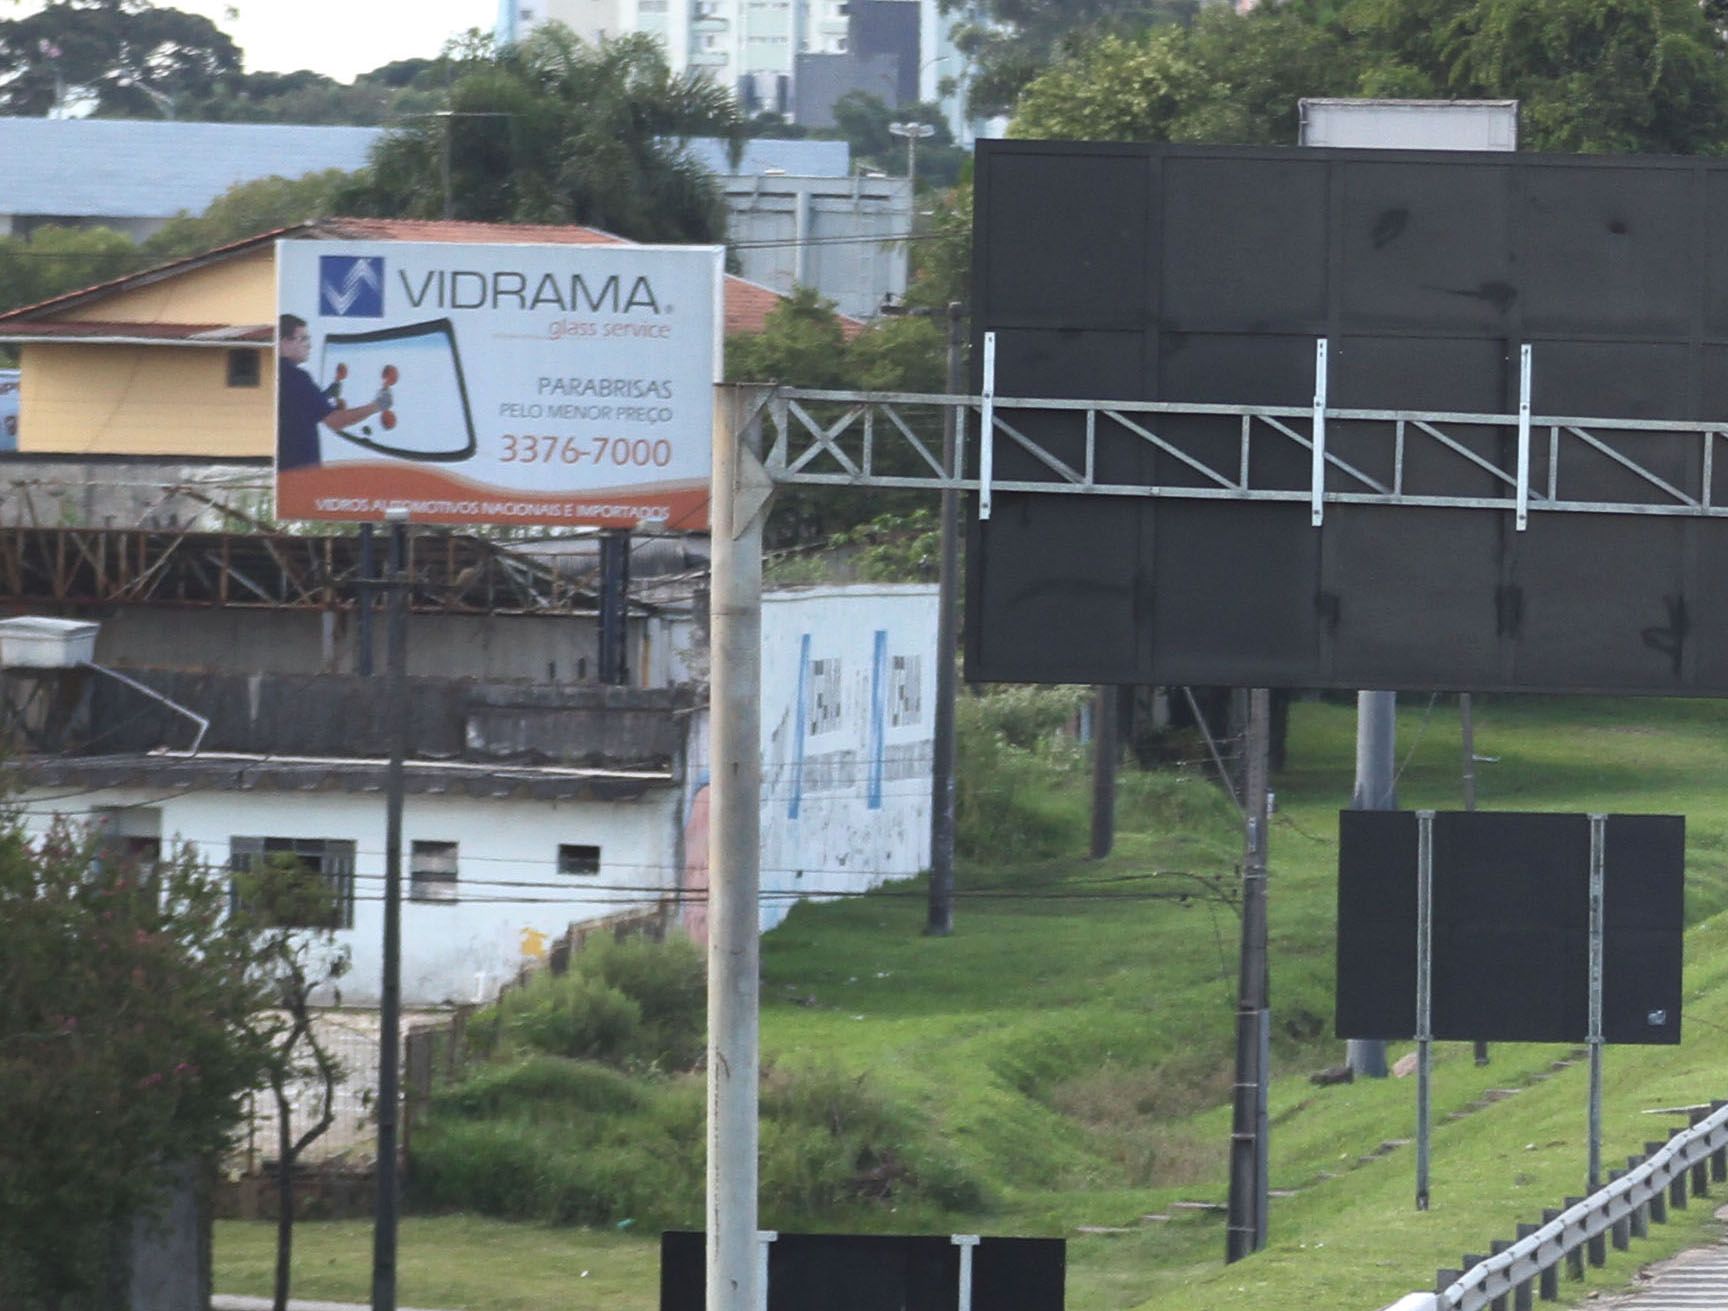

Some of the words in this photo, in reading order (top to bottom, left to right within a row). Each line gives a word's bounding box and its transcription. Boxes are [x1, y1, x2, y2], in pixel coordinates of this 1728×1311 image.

[400, 268, 661, 315] VIDRAMA
[548, 321, 597, 341] glass
[602, 321, 671, 339] service
[537, 377, 673, 400] PARABRISAS
[500, 402, 544, 419] PELO
[546, 404, 612, 421] MENOR
[616, 406, 673, 424] PREÇO
[500, 434, 672, 467] 3376-7000
[317, 499, 369, 513] VIDROS
[482, 502, 562, 517] NACIONAIS
[564, 504, 573, 517] E
[577, 504, 670, 520] IMPORTADOS
